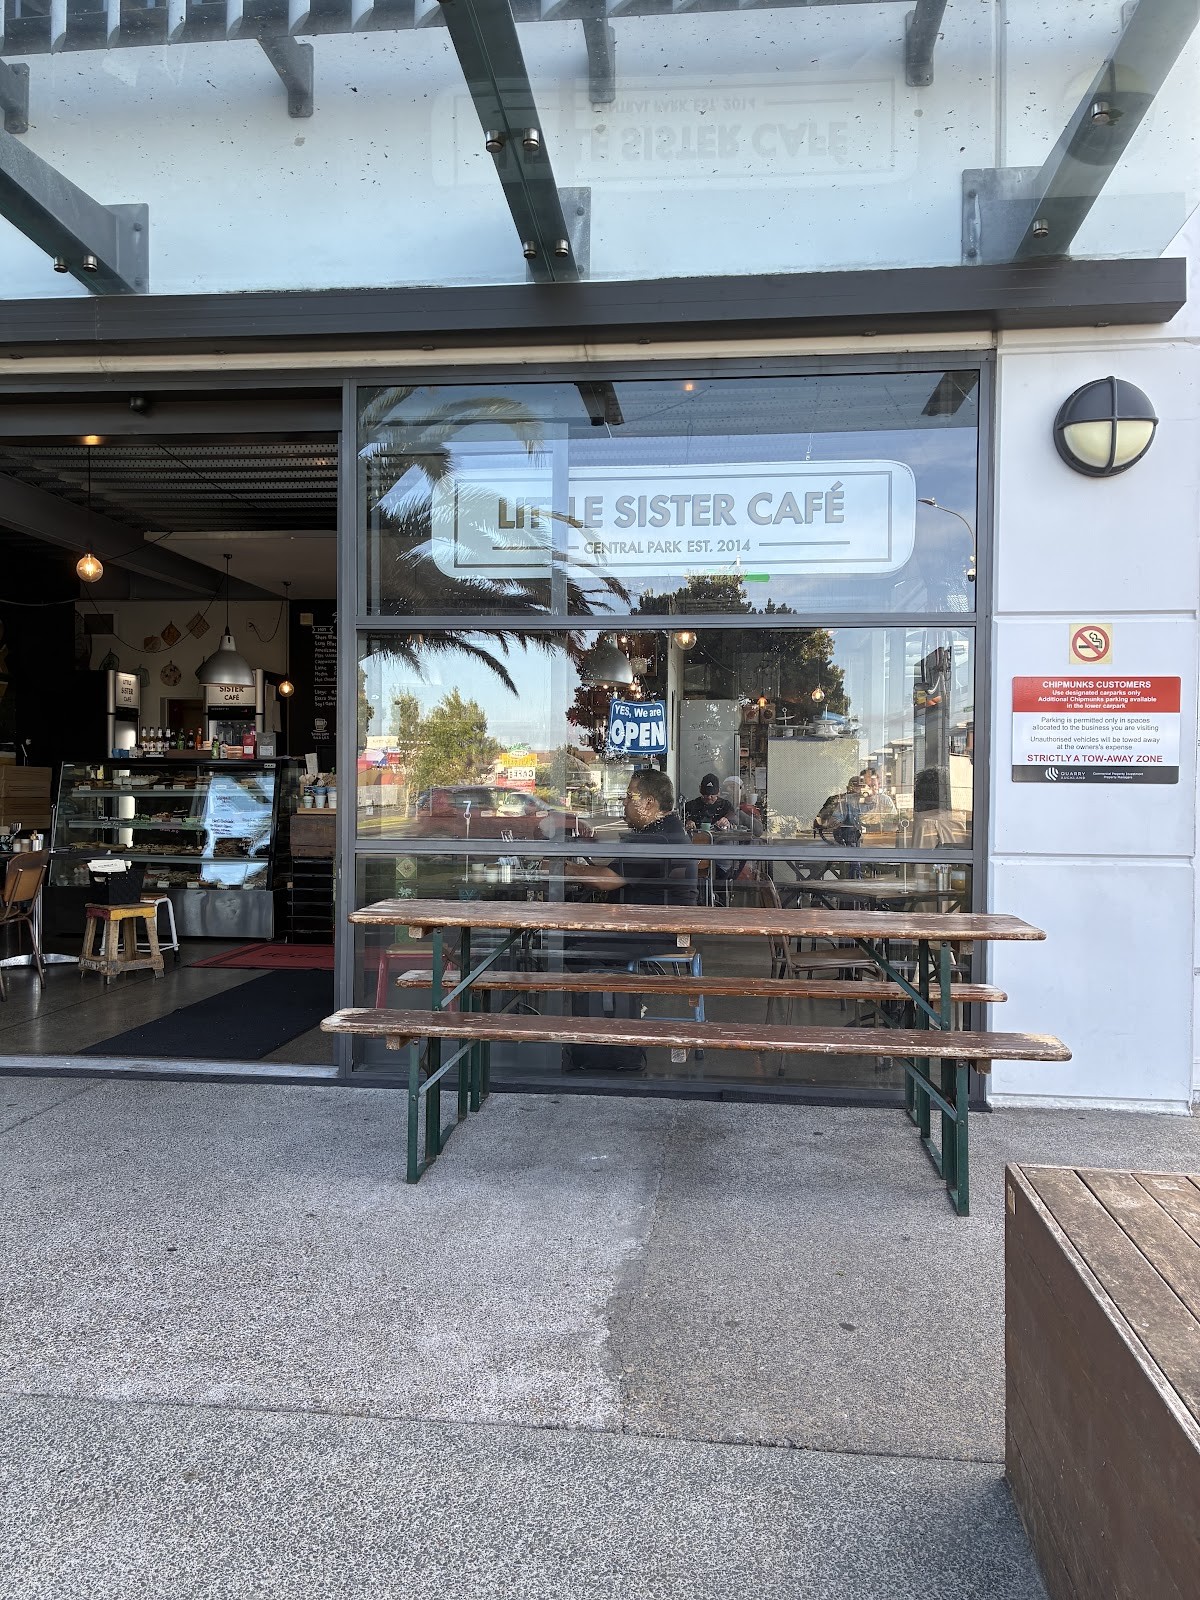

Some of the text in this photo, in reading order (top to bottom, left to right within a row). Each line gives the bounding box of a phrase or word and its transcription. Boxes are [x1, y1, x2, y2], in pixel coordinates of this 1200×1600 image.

[498, 480, 845, 529] LITLE SISTER CAFÉ
[583, 538, 751, 555] CENTRAL PARK EST. 2014
[1042, 680, 1151, 689] CHIPMUNKS CUSTOMERS
[615, 704, 661, 718] YES, We are
[1041, 716, 1065, 725] Parking
[1073, 717, 1104, 725] permitted
[1104, 717, 1119, 725] only
[1127, 717, 1151, 725] spaces
[611, 719, 665, 748] OPEN
[1136, 725, 1159, 733] visiting
[1030, 735, 1072, 743] Unauthorised
[1105, 744, 1133, 752] expense
[1027, 754, 1163, 763] STRICTLY A TOW-AWAY ZONE
